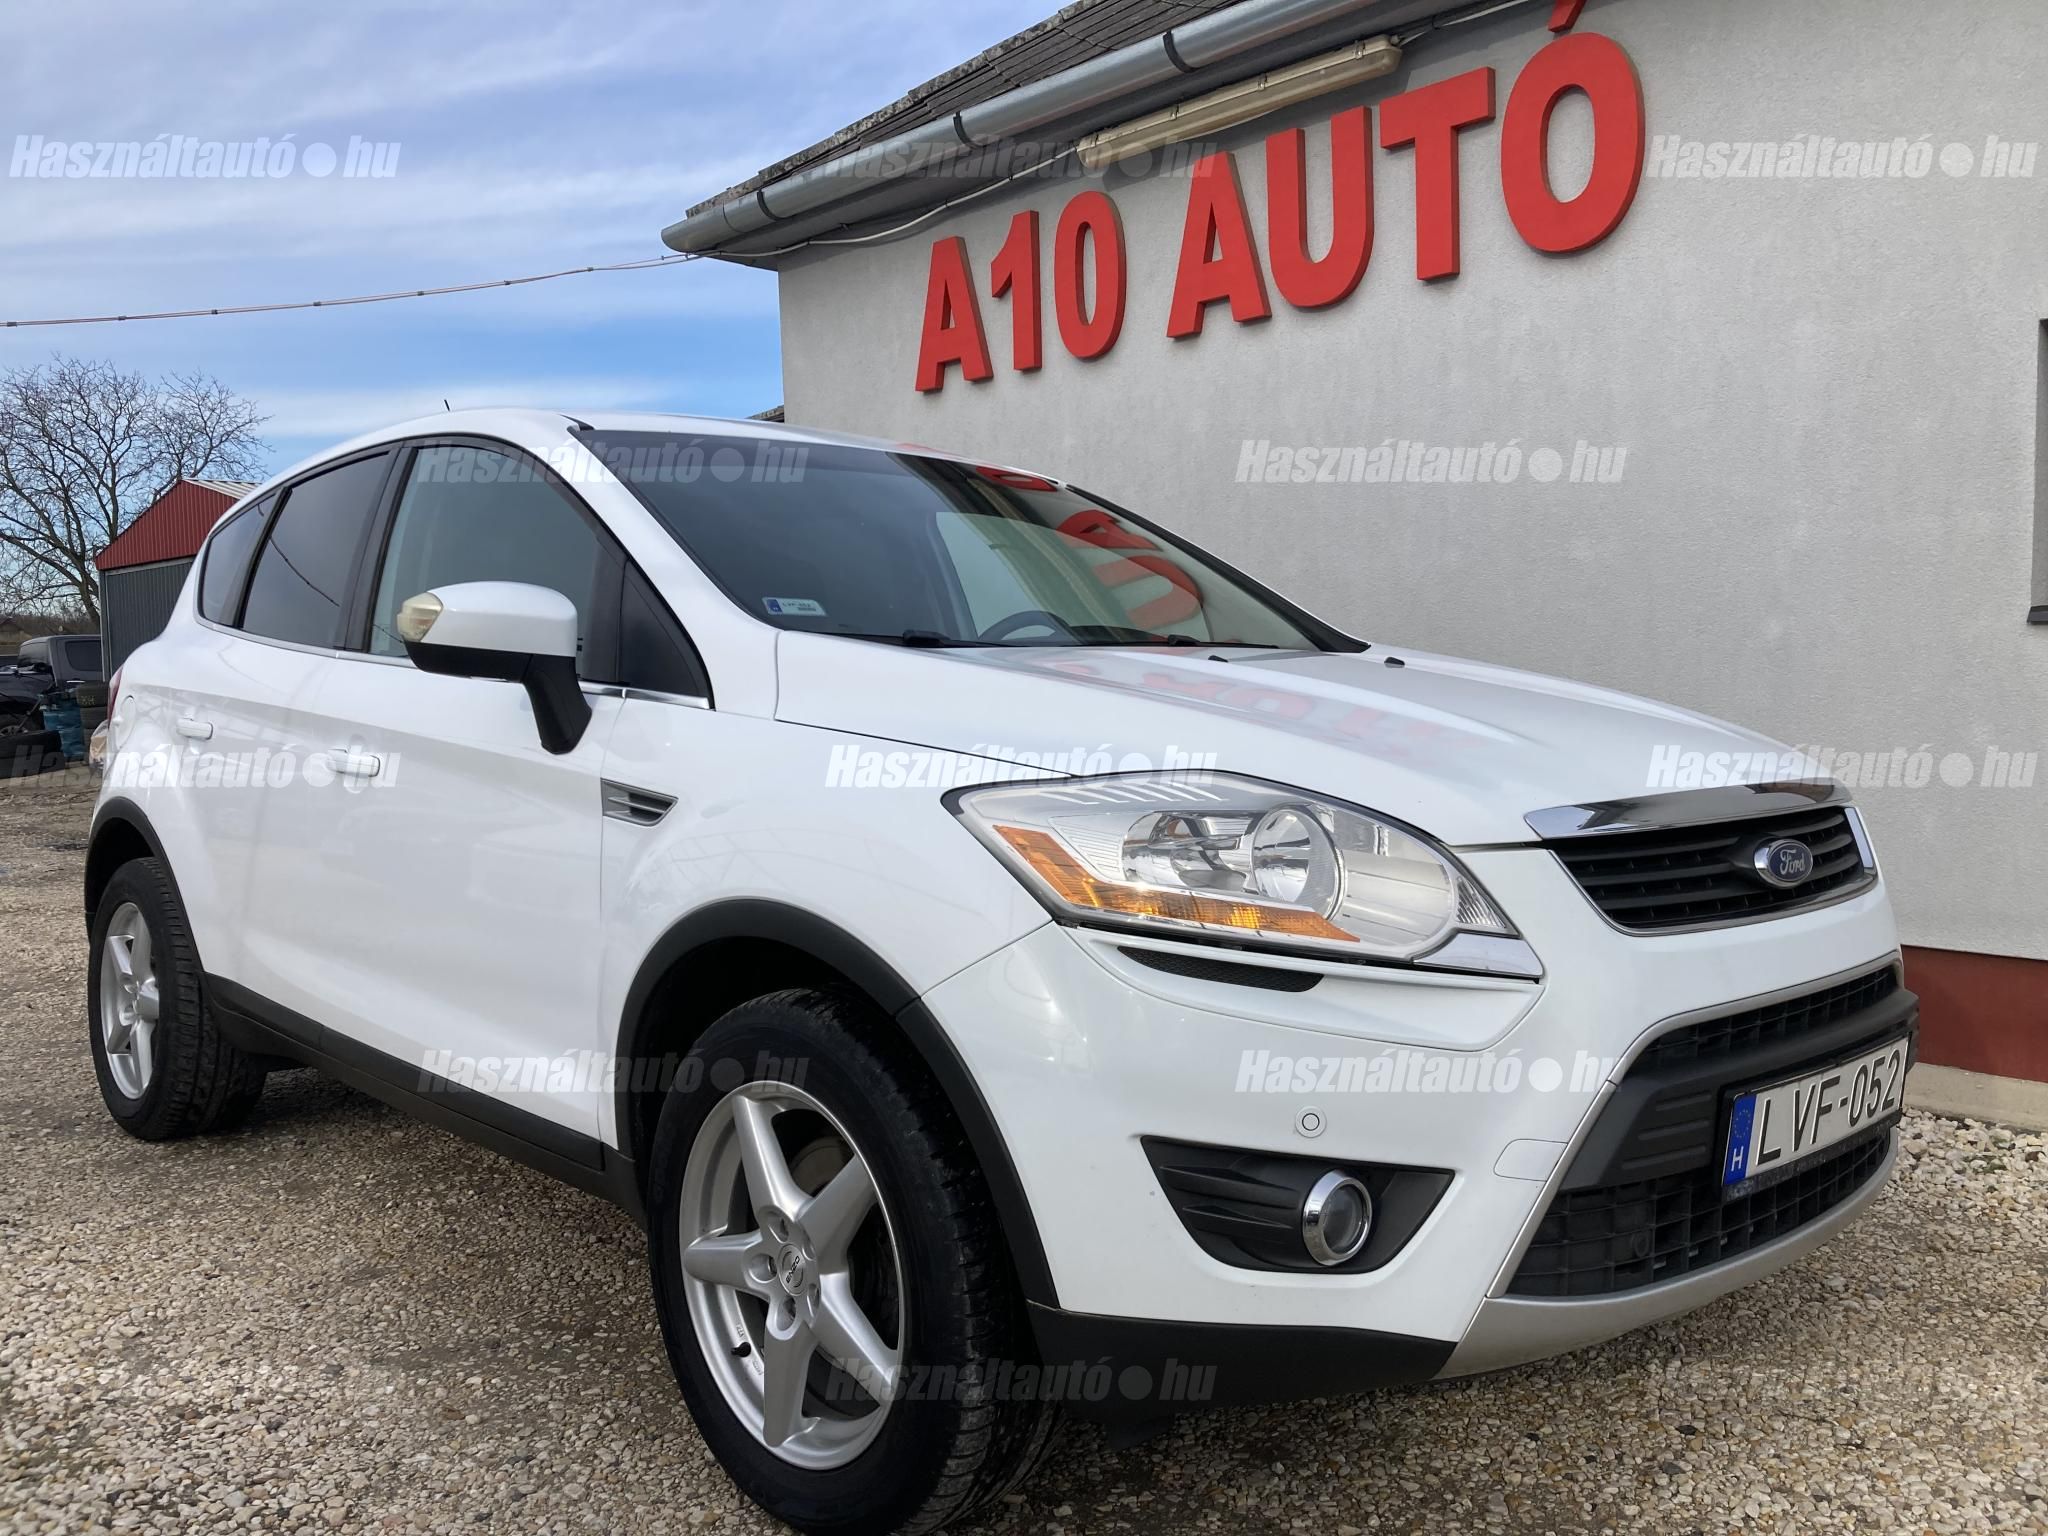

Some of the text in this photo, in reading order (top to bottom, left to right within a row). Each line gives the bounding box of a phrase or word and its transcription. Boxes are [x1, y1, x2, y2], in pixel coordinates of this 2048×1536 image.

[915, 0, 1646, 393] A10 AUTÓ
[1780, 849, 1805, 875] Ford
[1756, 1049, 1900, 1166] LVF-052
[1731, 1146, 1744, 1172] H
[786, 1256, 800, 1283] ENZO
